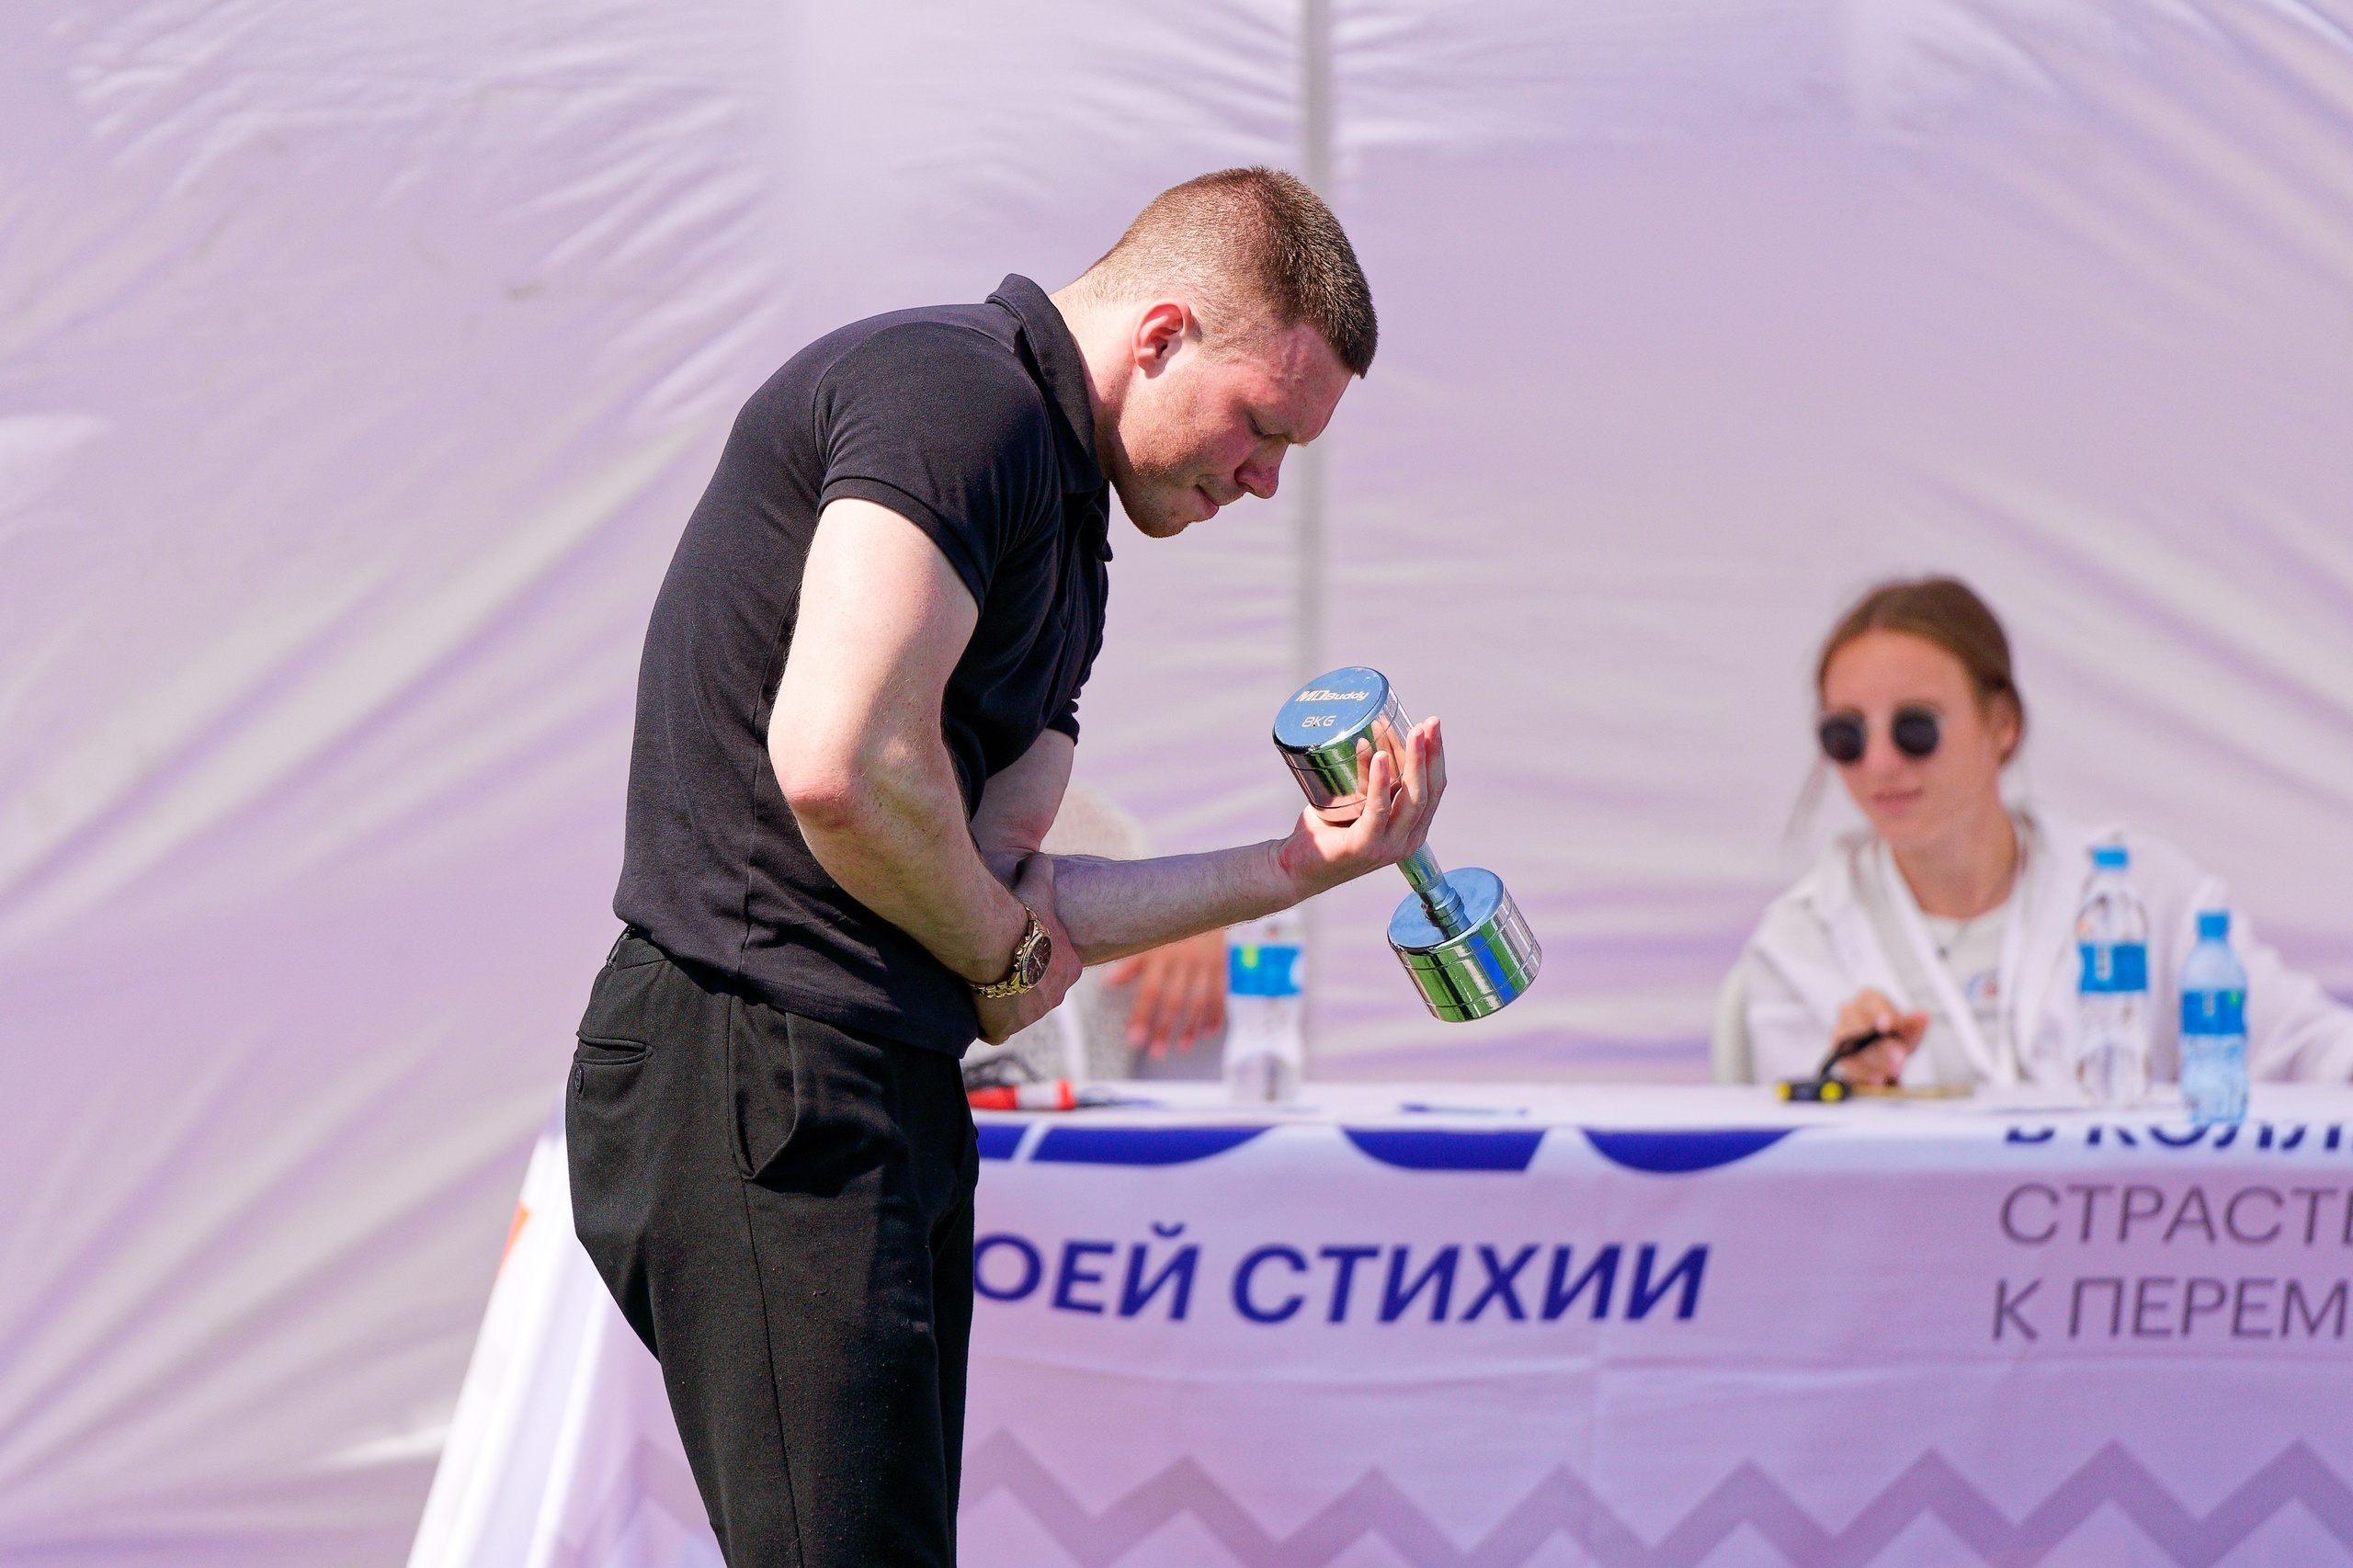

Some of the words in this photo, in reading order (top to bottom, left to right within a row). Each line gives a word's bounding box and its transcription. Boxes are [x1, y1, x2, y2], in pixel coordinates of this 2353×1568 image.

[1294, 689, 1370, 702] MDBuddy
[1302, 715, 1337, 728] 8KG
[1231, 1242, 1711, 1326] СТИХИИ
[1991, 1278, 2042, 1342] К
[2067, 1275, 2350, 1341] ПЕРЕМ
